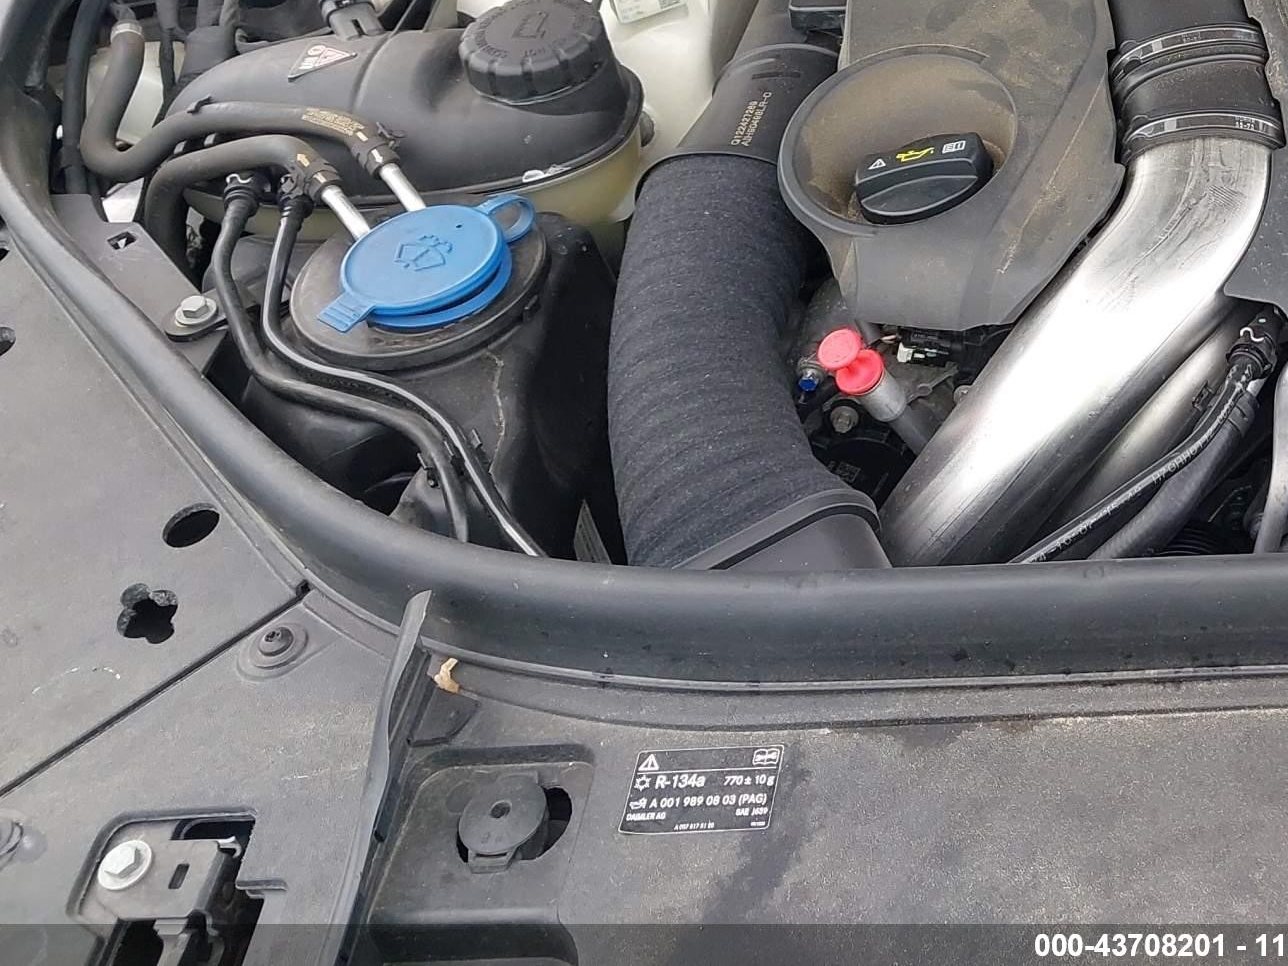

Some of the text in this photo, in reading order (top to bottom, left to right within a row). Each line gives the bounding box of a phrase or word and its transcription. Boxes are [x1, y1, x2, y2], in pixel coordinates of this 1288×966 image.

[655, 774, 706, 789] R-134a
[723, 775, 741, 786] 770
[755, 775, 766, 785] 10
[649, 793, 768, 808] A 001 989 08 03 (PAG)
